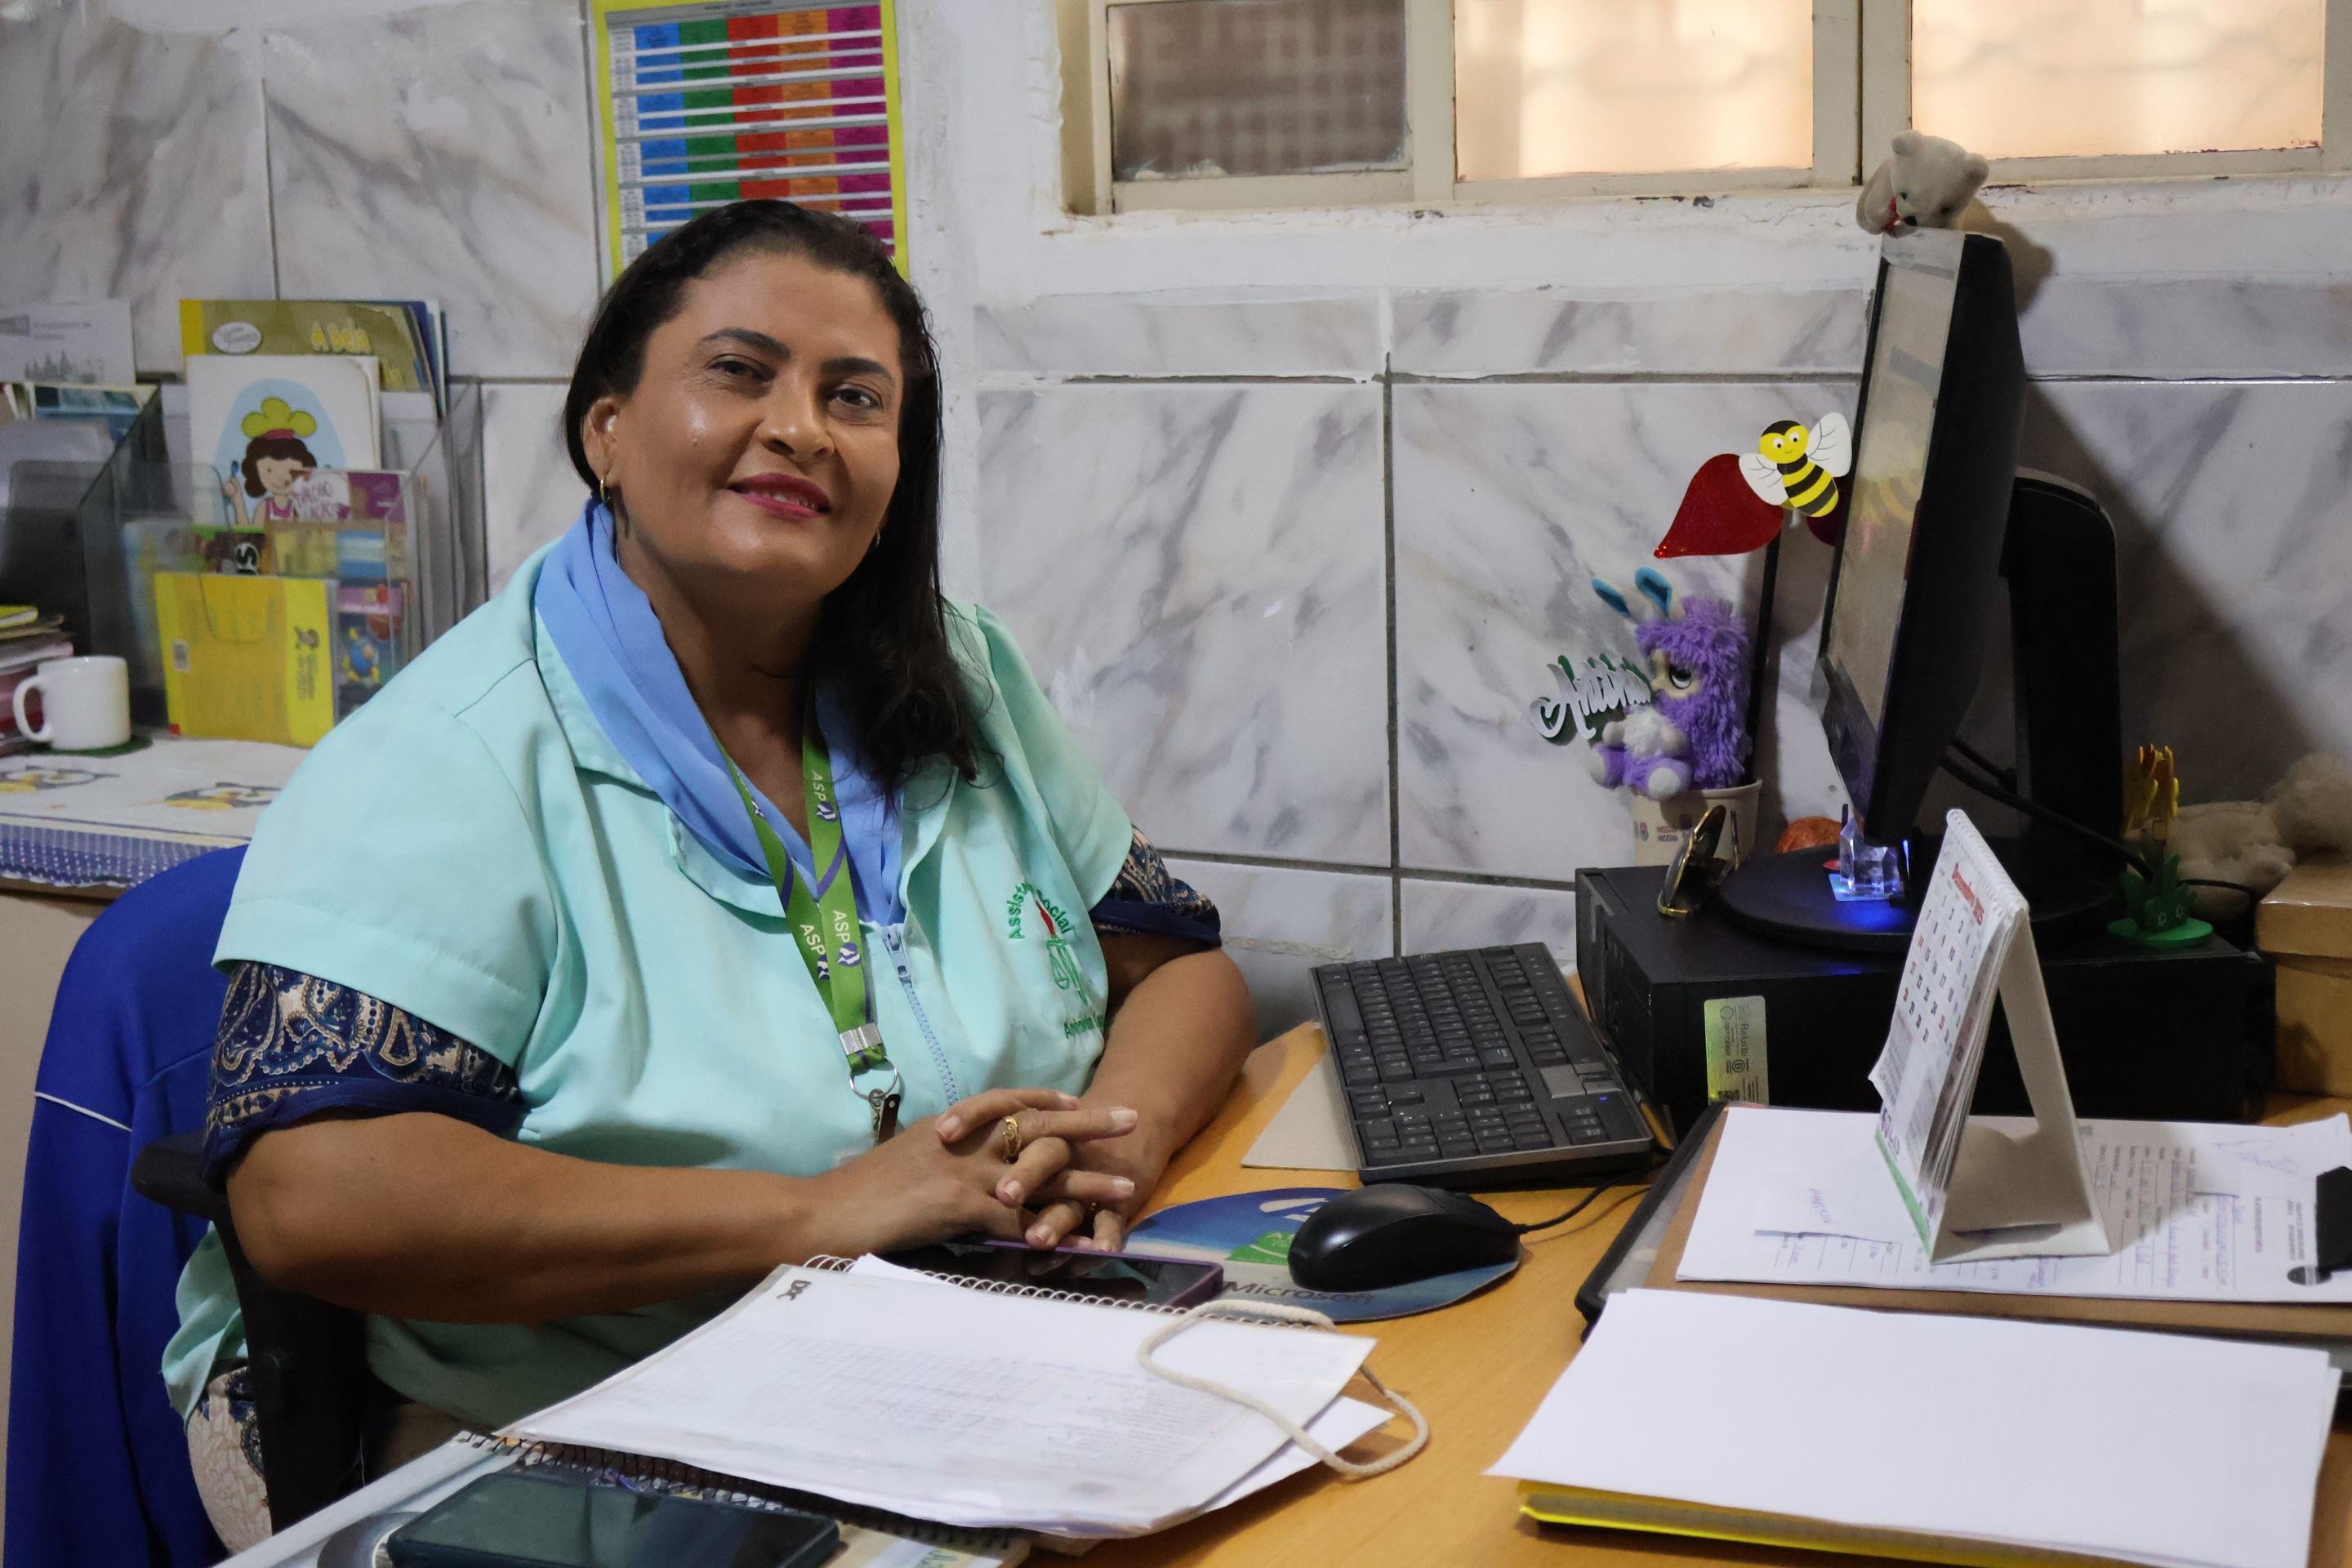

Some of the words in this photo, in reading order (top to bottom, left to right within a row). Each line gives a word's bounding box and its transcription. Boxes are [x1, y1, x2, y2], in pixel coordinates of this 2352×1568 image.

[811, 770, 827, 802] ASP
[800, 923, 826, 956] ASP
[832, 911, 851, 943] ASP
